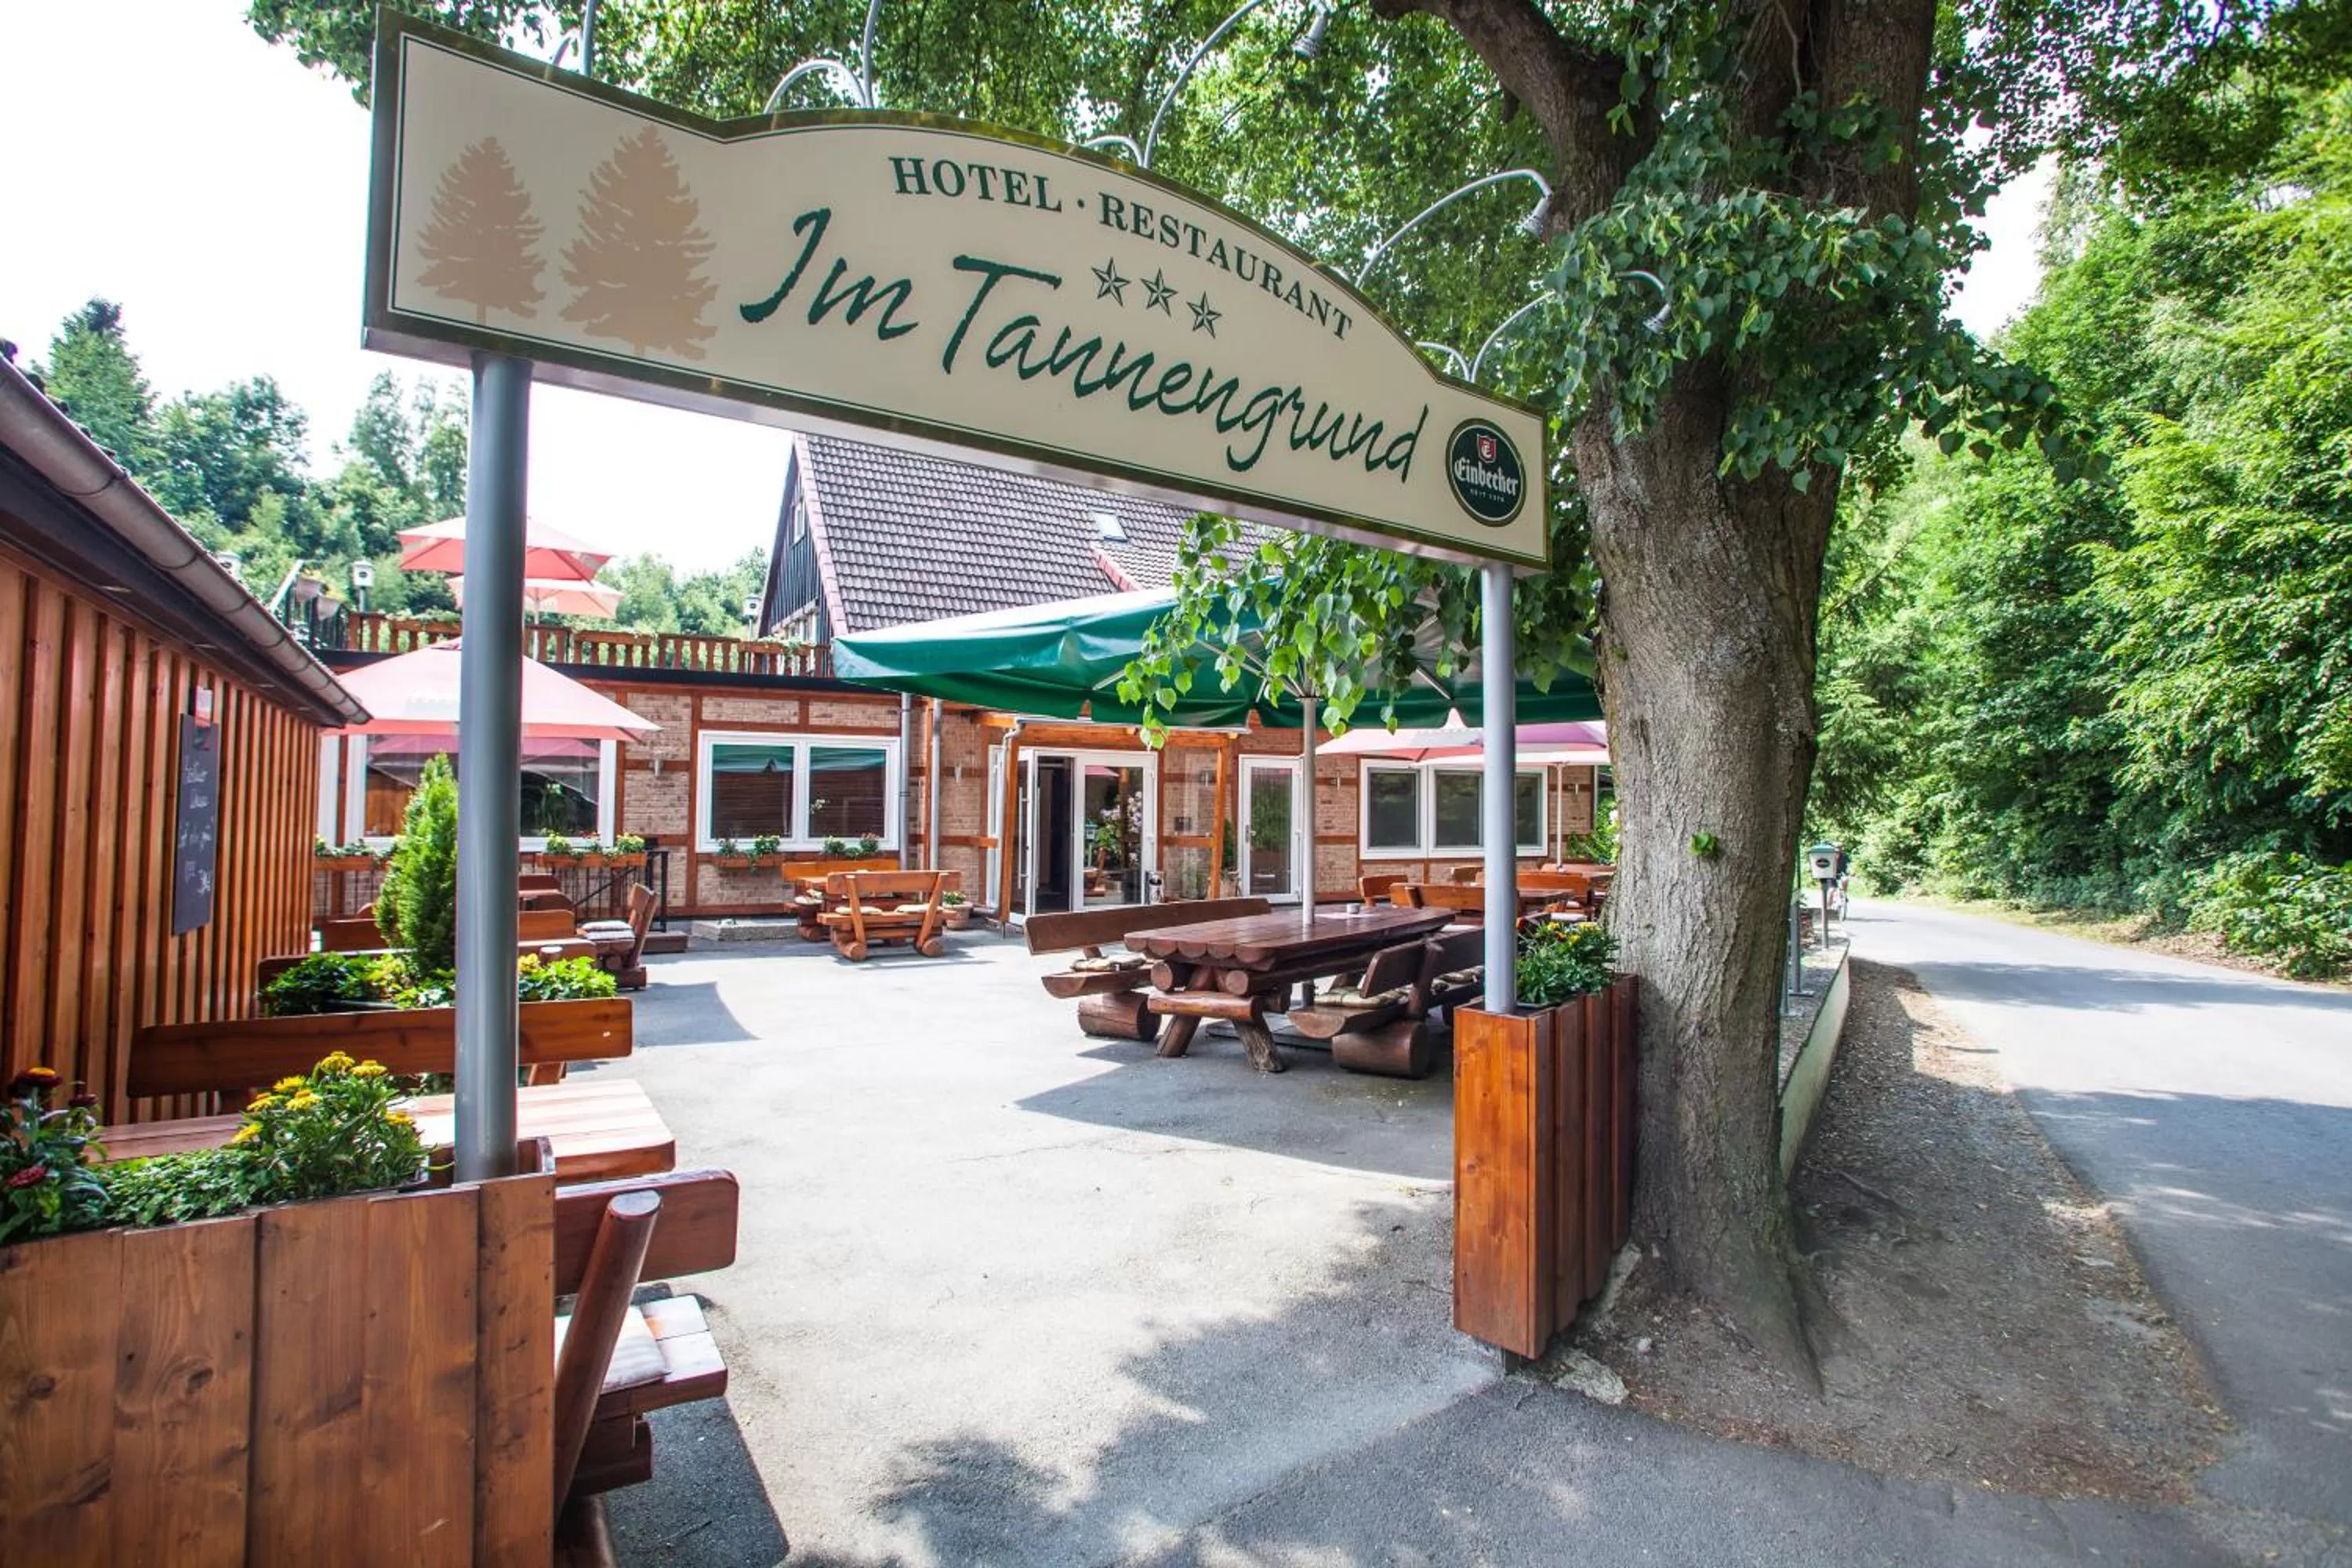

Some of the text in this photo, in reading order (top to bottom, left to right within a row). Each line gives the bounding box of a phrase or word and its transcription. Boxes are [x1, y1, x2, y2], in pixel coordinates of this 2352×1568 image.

[889, 157, 1352, 339] HOTEL RESTAURANT
[740, 208, 1428, 483] Im Tannengrund
[1454, 457, 1519, 495] Einbecker
